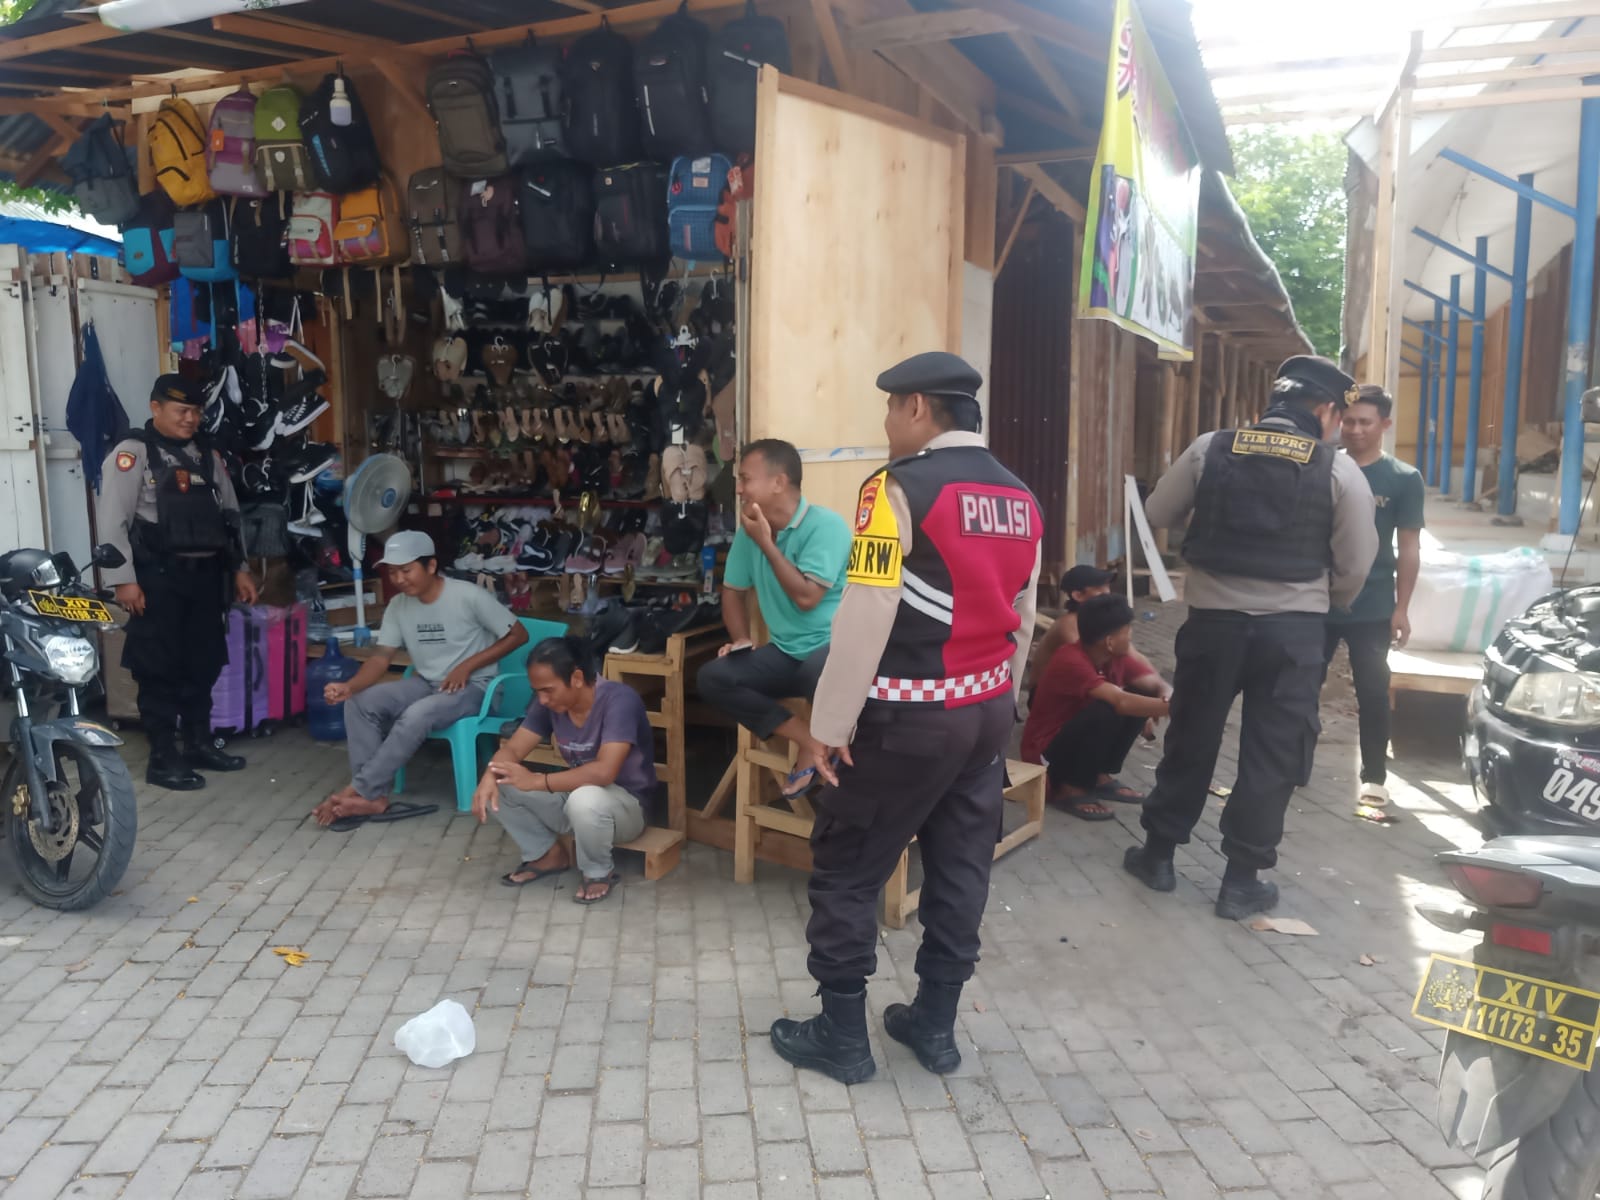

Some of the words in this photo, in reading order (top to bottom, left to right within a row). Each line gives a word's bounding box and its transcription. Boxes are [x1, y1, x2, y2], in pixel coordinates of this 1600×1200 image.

[1242, 433, 1267, 444] TIM
[962, 494, 1031, 537] POLISI
[864, 541, 893, 575] RW
[1498, 978, 1567, 1015] XIV
